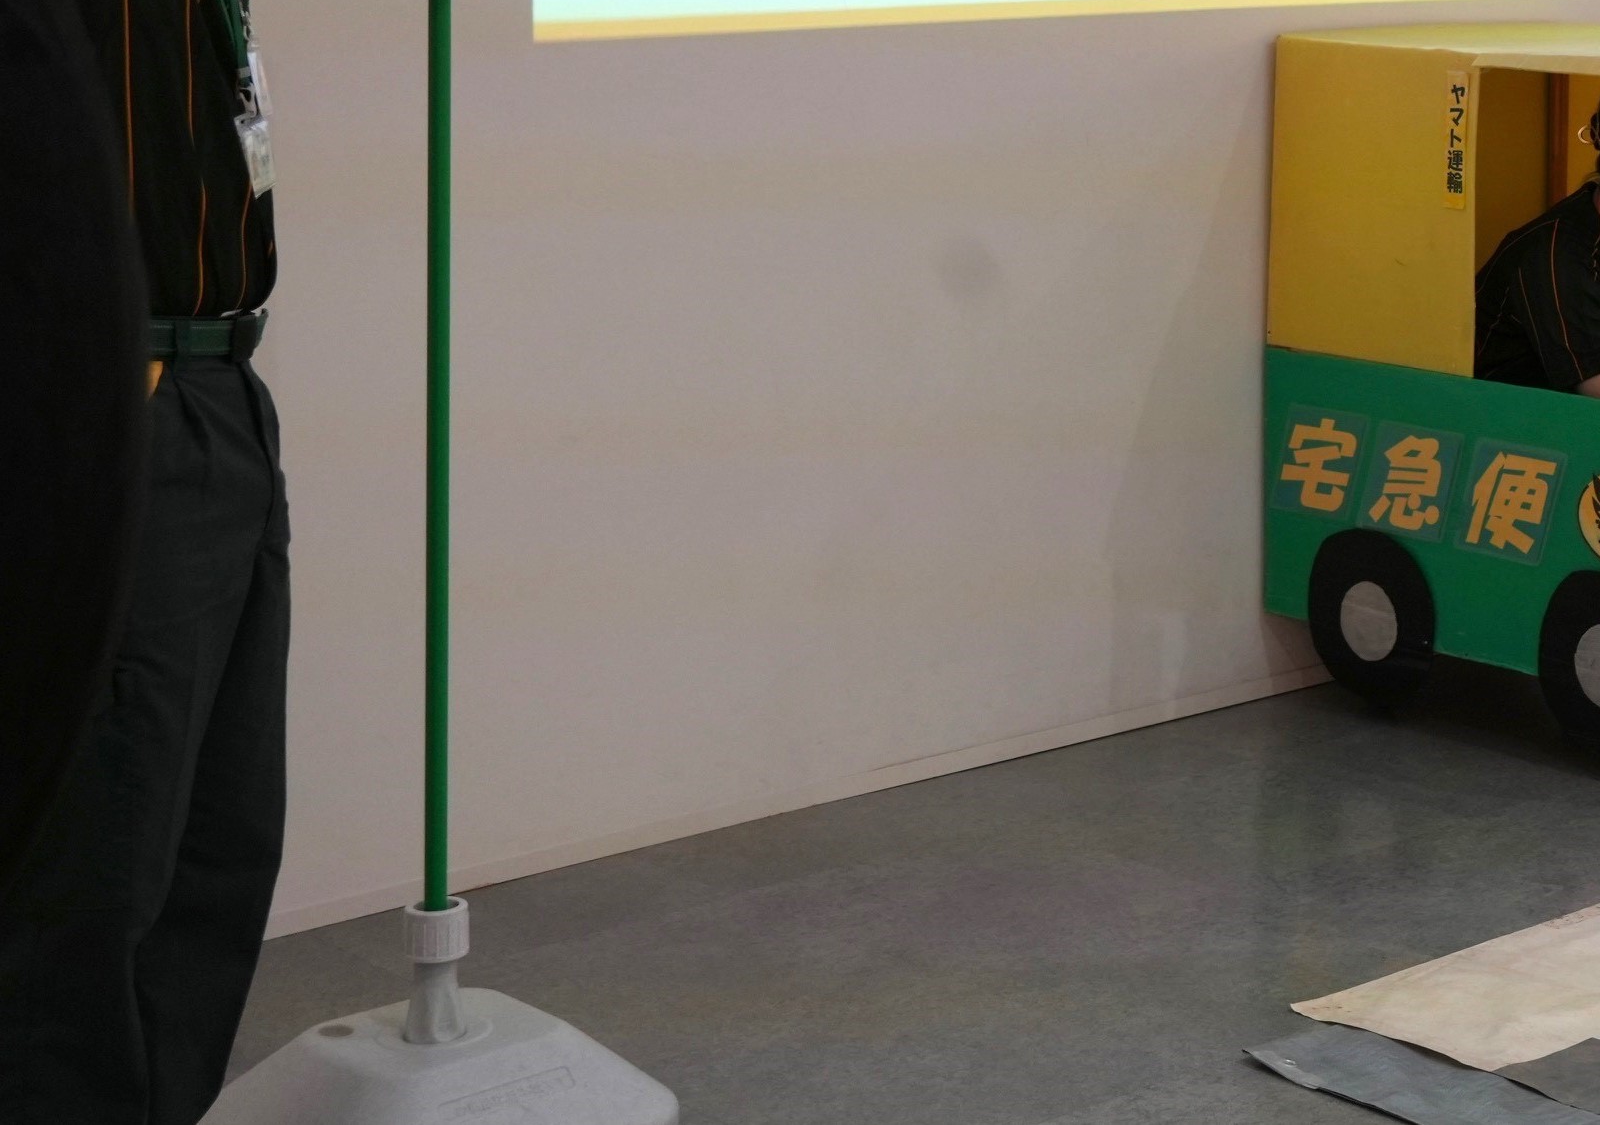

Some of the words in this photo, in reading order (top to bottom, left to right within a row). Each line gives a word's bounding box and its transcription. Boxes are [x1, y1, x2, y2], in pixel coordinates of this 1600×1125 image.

[1447, 84, 1465, 194] ヤマト運輸
[1280, 417, 1558, 555] 宅急便
